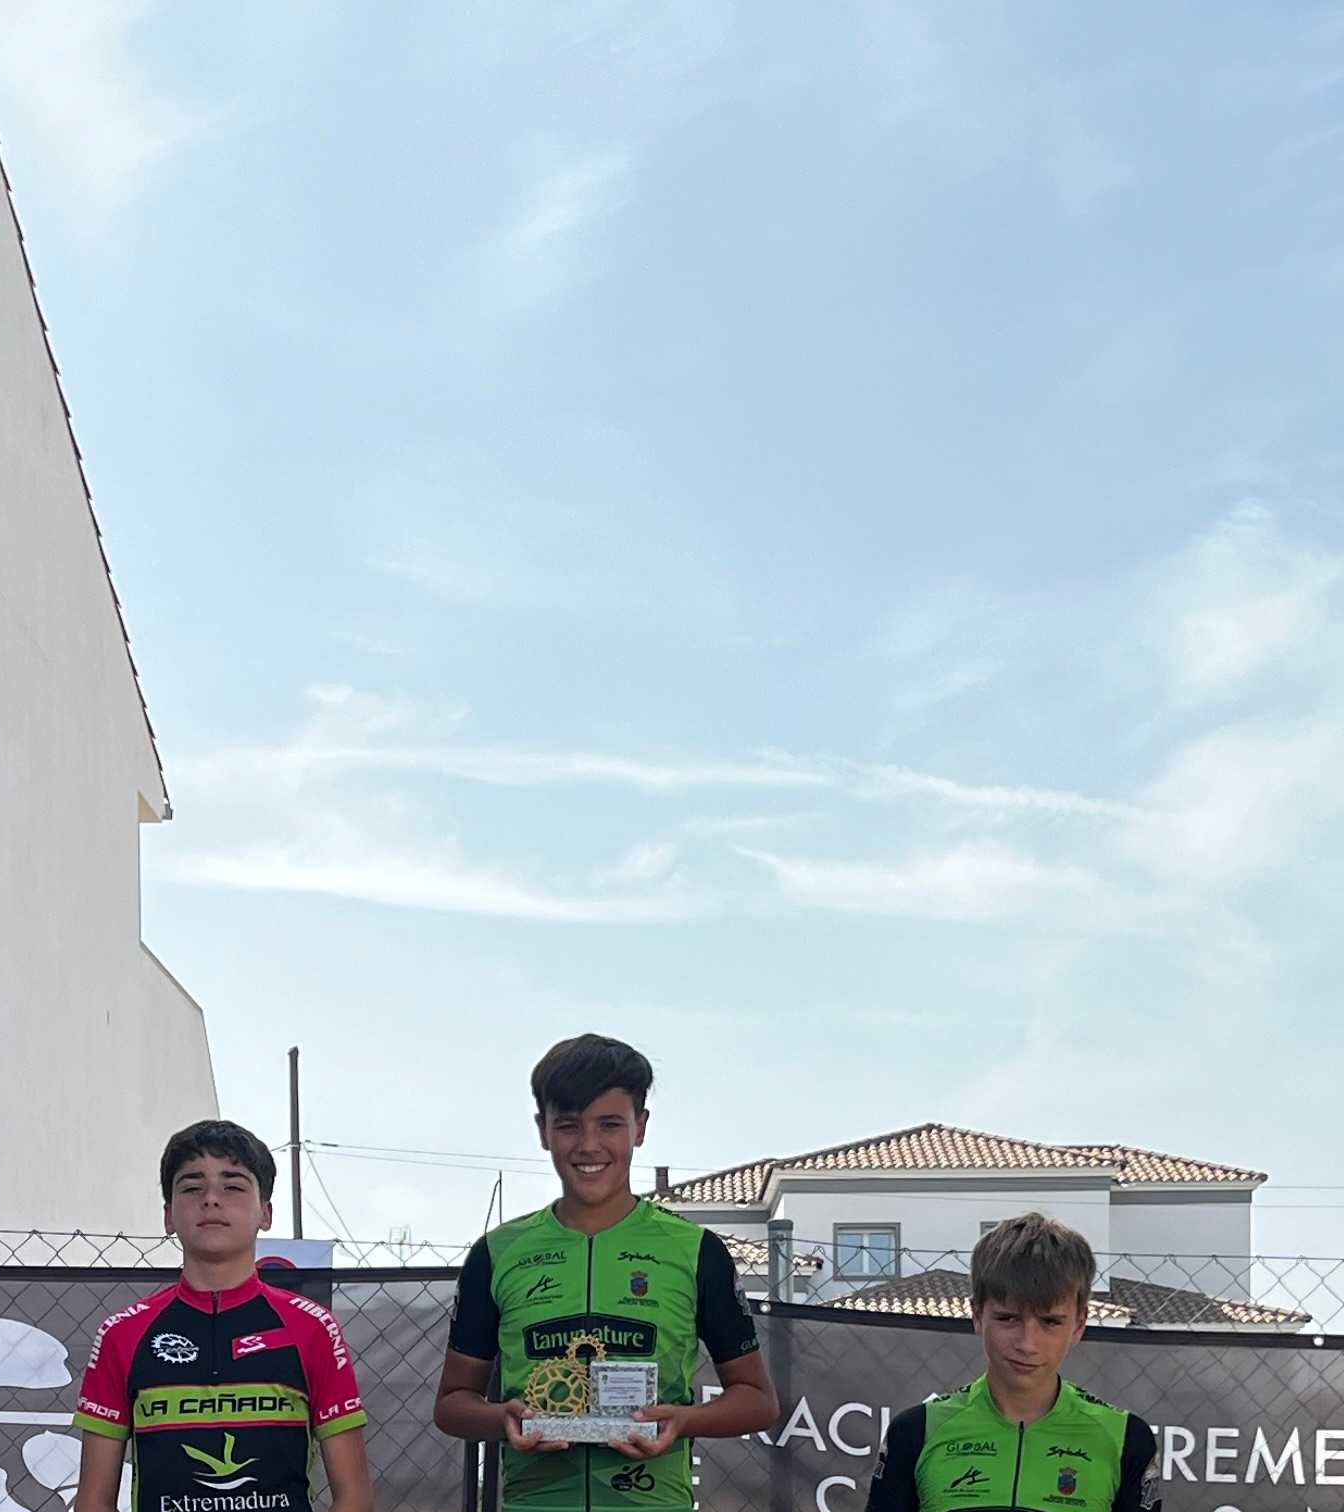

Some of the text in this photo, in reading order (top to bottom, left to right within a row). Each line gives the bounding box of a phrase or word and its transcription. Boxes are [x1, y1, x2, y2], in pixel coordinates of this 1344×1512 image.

[289, 1297, 349, 1371] HIBERNIA
[79, 1396, 121, 1420] ÑADA
[179, 1394, 296, 1415] CAÑADA
